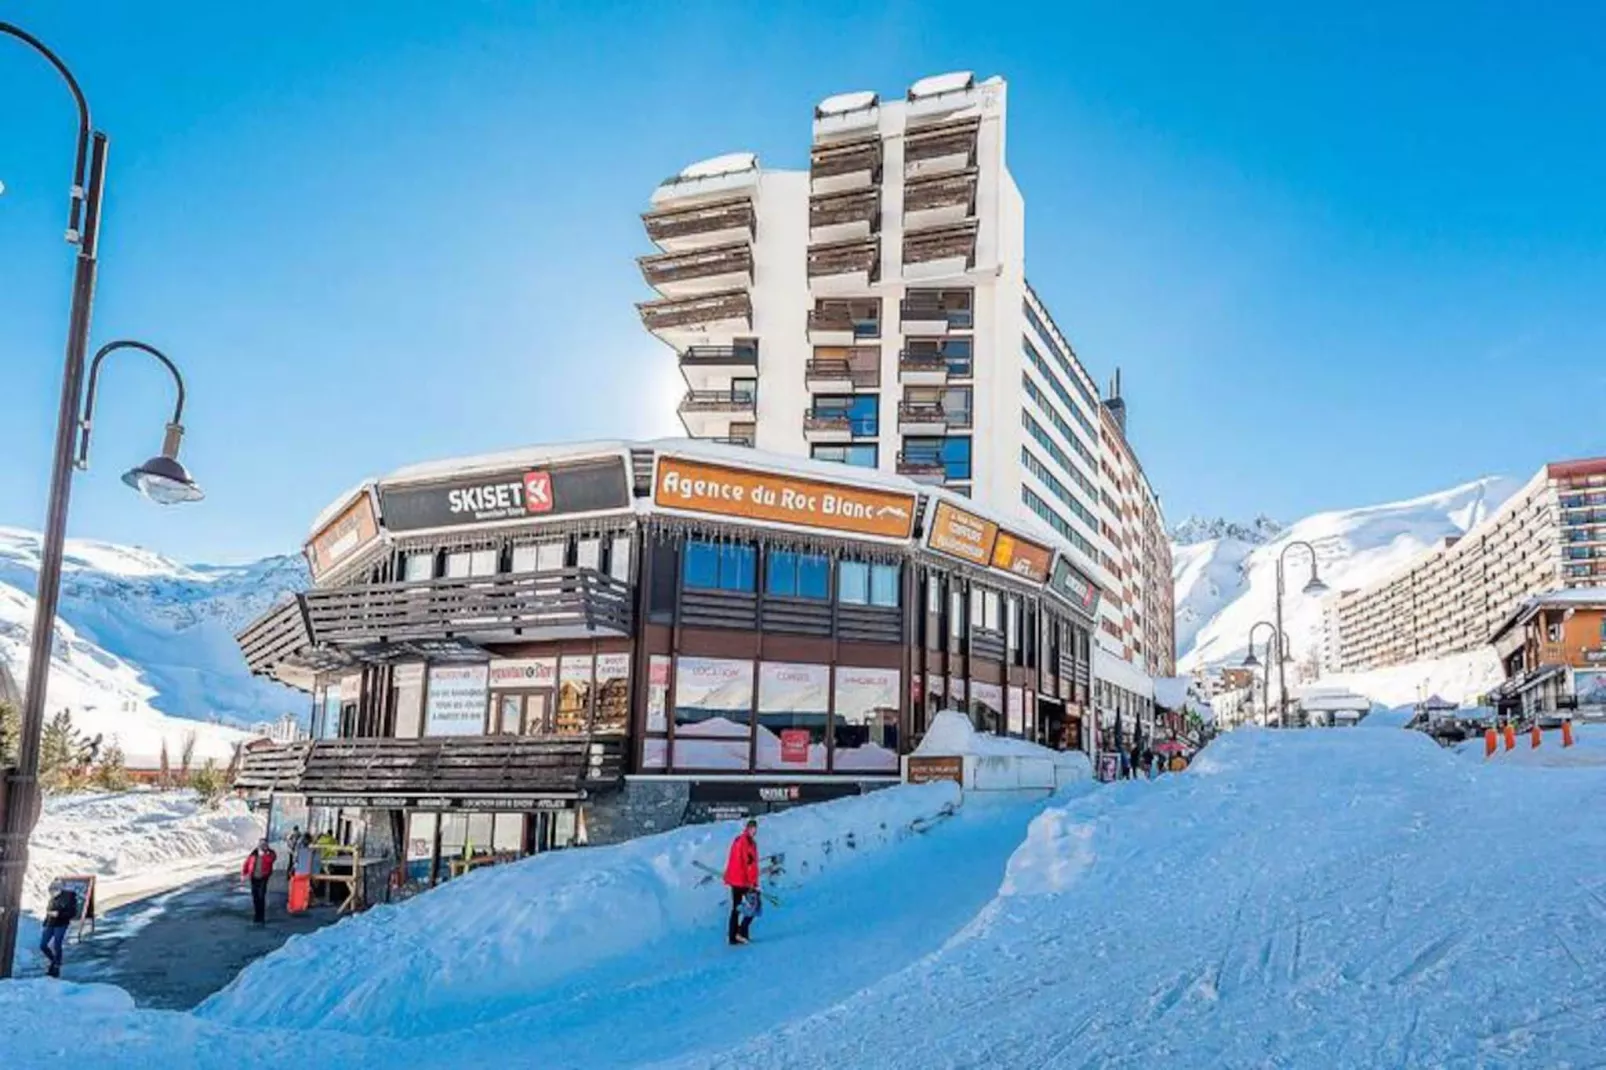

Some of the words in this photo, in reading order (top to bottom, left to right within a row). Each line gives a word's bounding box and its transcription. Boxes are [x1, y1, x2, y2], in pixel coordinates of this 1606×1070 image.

[448, 483, 523, 514] SKISET
[664, 471, 744, 501] Agence
[751, 485, 775, 505] du
[780, 488, 816, 511] Roc
[822, 494, 873, 519] Blanc
